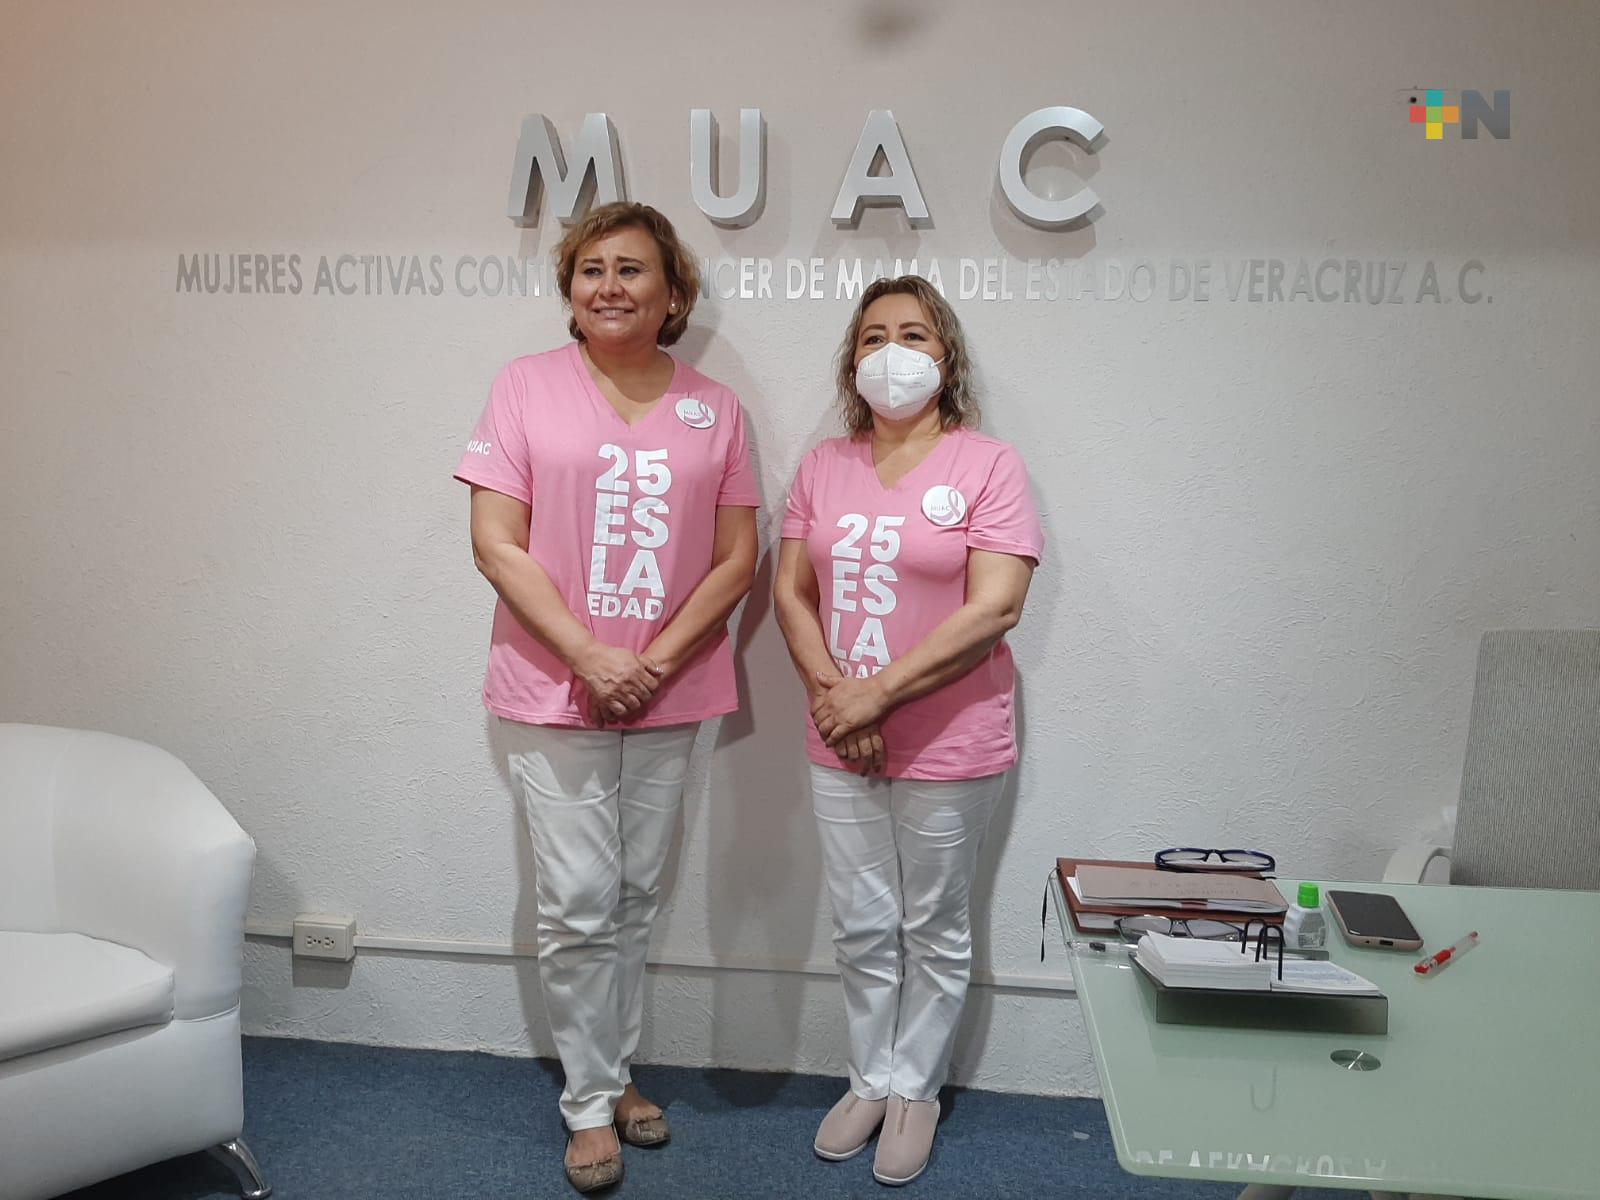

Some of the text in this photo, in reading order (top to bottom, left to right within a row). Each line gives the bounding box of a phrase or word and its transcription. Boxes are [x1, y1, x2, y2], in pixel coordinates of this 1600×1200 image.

[508, 106, 1105, 226] MUAC
[175, 253, 302, 294] MUJERES
[313, 255, 443, 296] ACTIVAS
[786, 257, 825, 299] DE
[958, 258, 1013, 300] DEL
[1025, 258, 1156, 301] ESTADO
[1168, 259, 1210, 302] DE
[1223, 259, 1405, 305] VERACRUZ
[596, 444, 672, 496] 25
[593, 493, 670, 549] ES
[831, 513, 905, 562] 25
[588, 545, 666, 597] LA
[831, 560, 898, 616] ES
[587, 593, 664, 621] EDAD
[829, 611, 892, 666] LA
